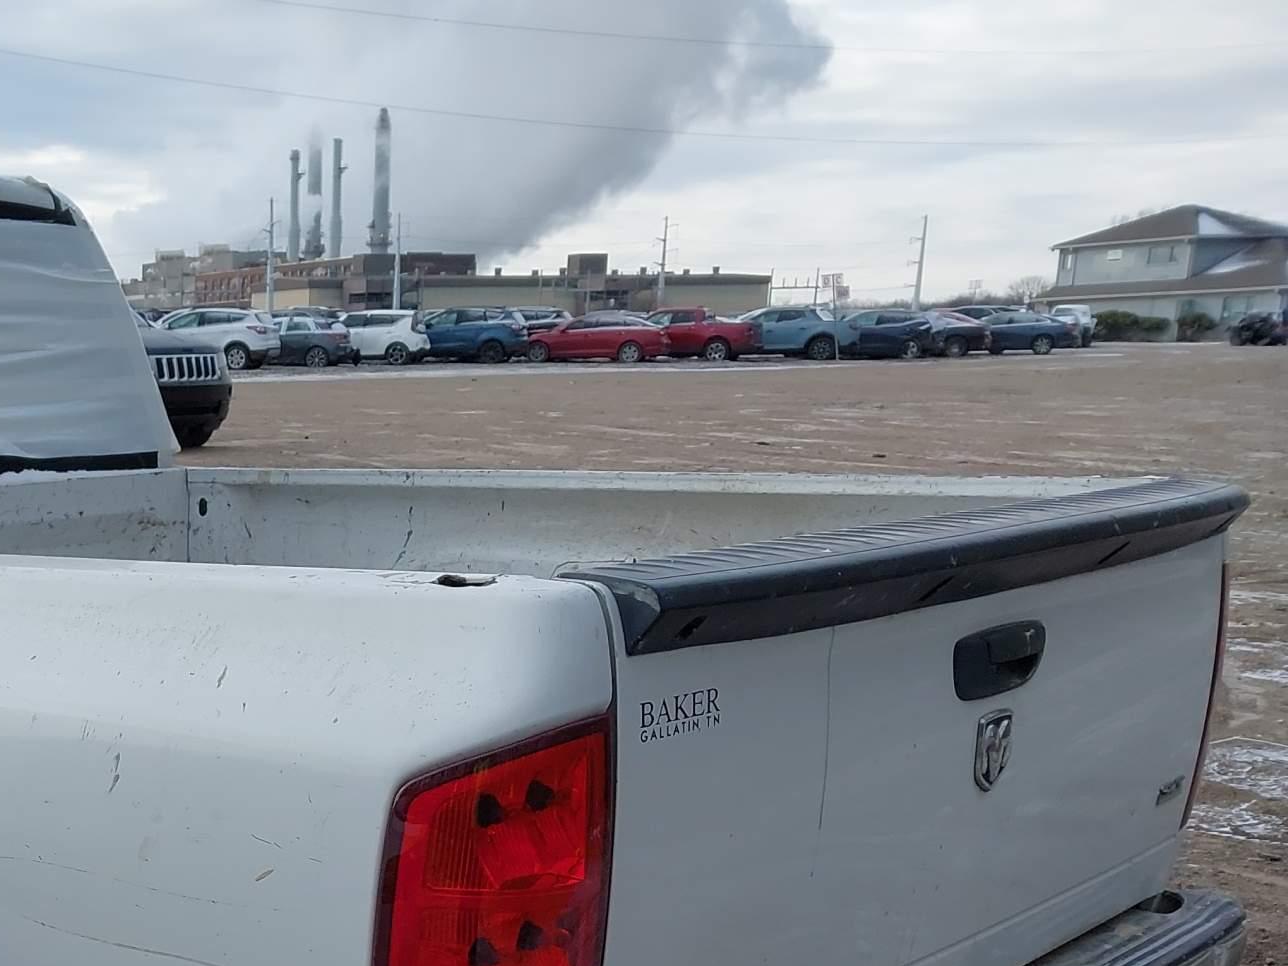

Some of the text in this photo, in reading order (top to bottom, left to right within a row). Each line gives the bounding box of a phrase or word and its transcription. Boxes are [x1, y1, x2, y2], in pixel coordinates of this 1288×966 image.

[640, 687, 720, 729] BAKER
[640, 713, 720, 743] GALLATIN TN
